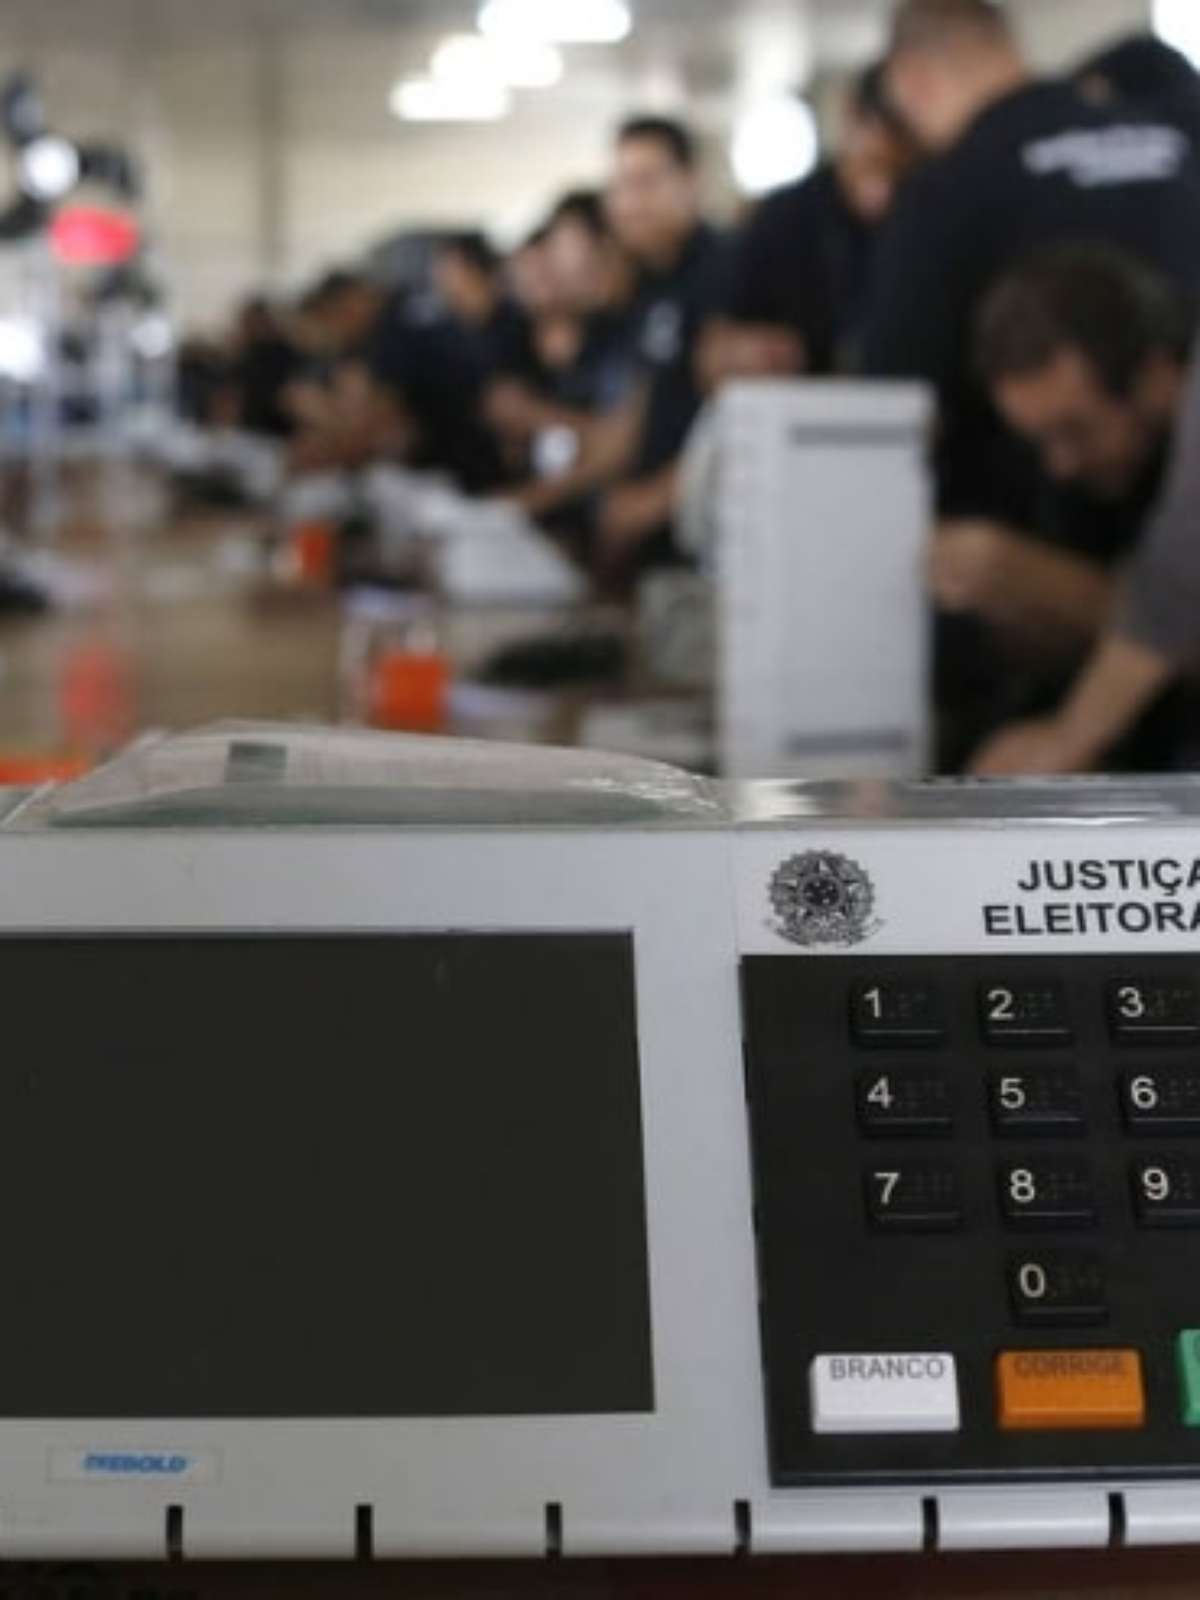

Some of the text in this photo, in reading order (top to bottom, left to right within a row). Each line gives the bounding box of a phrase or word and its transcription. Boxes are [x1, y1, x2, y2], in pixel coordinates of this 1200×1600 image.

[864, 987, 881, 1018] 1
[987, 989, 1013, 1020] 2
[1118, 986, 1145, 1018] 3
[866, 1077, 893, 1109] 4
[1000, 1077, 1026, 1109] 5
[1130, 1076, 1158, 1109] 6
[874, 1172, 900, 1204] 7
[1010, 1169, 1036, 1202] 8
[1142, 1168, 1169, 1200] 9
[1019, 1263, 1046, 1298] 0
[829, 1358, 946, 1380] BRANCO
